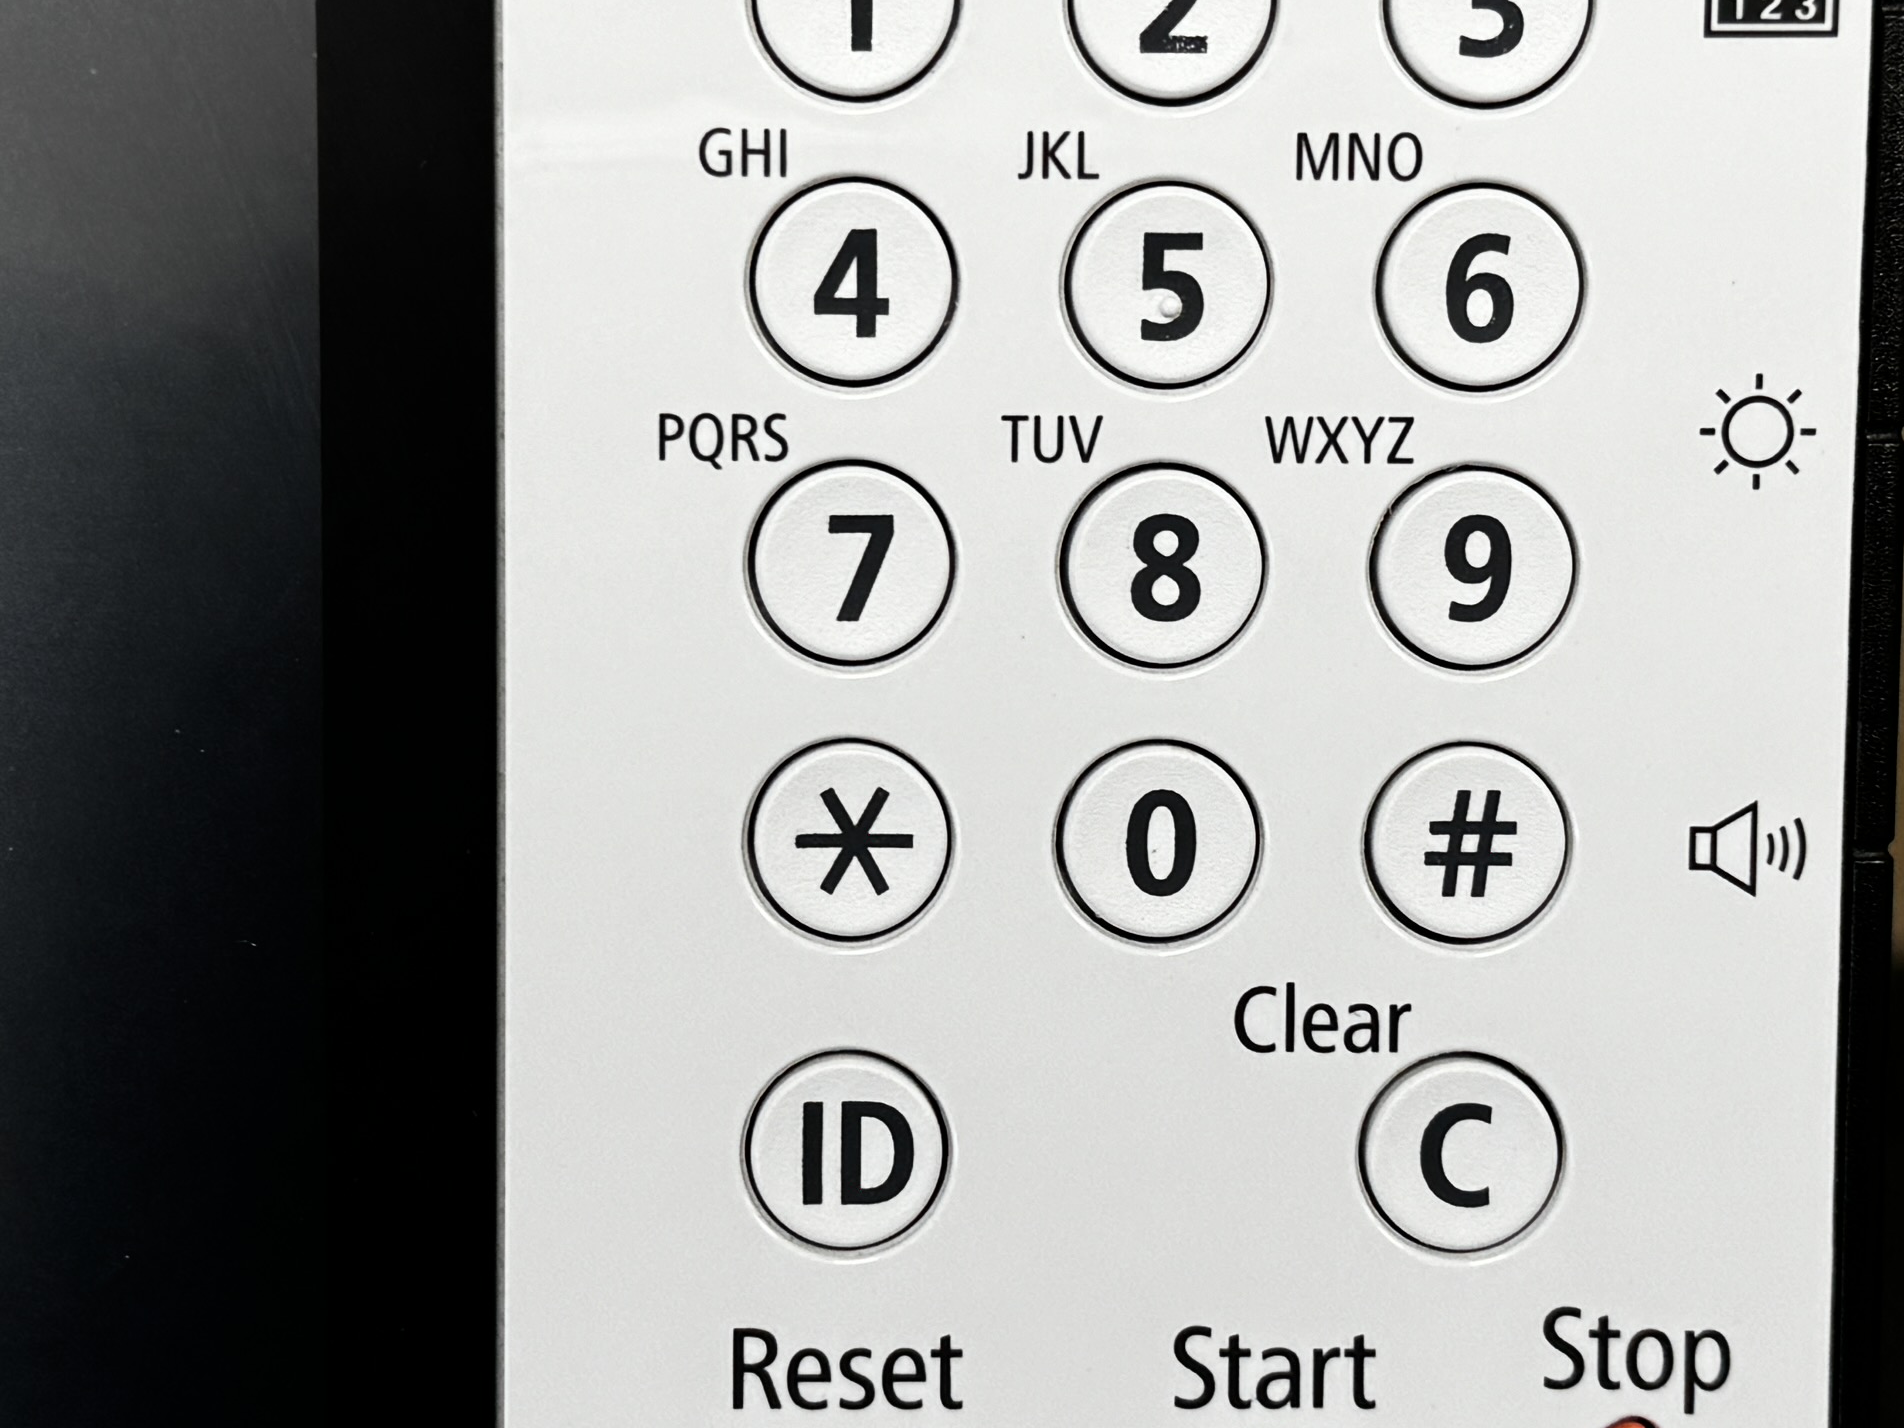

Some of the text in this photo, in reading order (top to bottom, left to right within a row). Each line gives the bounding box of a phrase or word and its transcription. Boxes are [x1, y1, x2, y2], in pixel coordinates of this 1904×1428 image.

[697, 126, 788, 179] GHI
[1016, 129, 1101, 181] JKL
[1294, 130, 1424, 183] MNO
[812, 227, 891, 339] 4
[1139, 230, 1206, 343] 5
[1444, 231, 1516, 345] 6
[657, 411, 790, 464] PQRS
[999, 413, 1105, 465] TUV
[1263, 414, 1416, 466] WXYZ
[826, 513, 896, 623] 7
[1129, 512, 1203, 624] 8
[1443, 513, 1514, 624] 9
[1124, 787, 1198, 898] 0
[1422, 788, 1519, 899] #
[1232, 980, 1413, 1055] Clear
[800, 1099, 916, 1207] ID
[1418, 1101, 1494, 1210] C
[731, 1326, 965, 1412] Reset
[1172, 1324, 1378, 1411] Start
[1541, 1305, 1733, 1413] Stop
